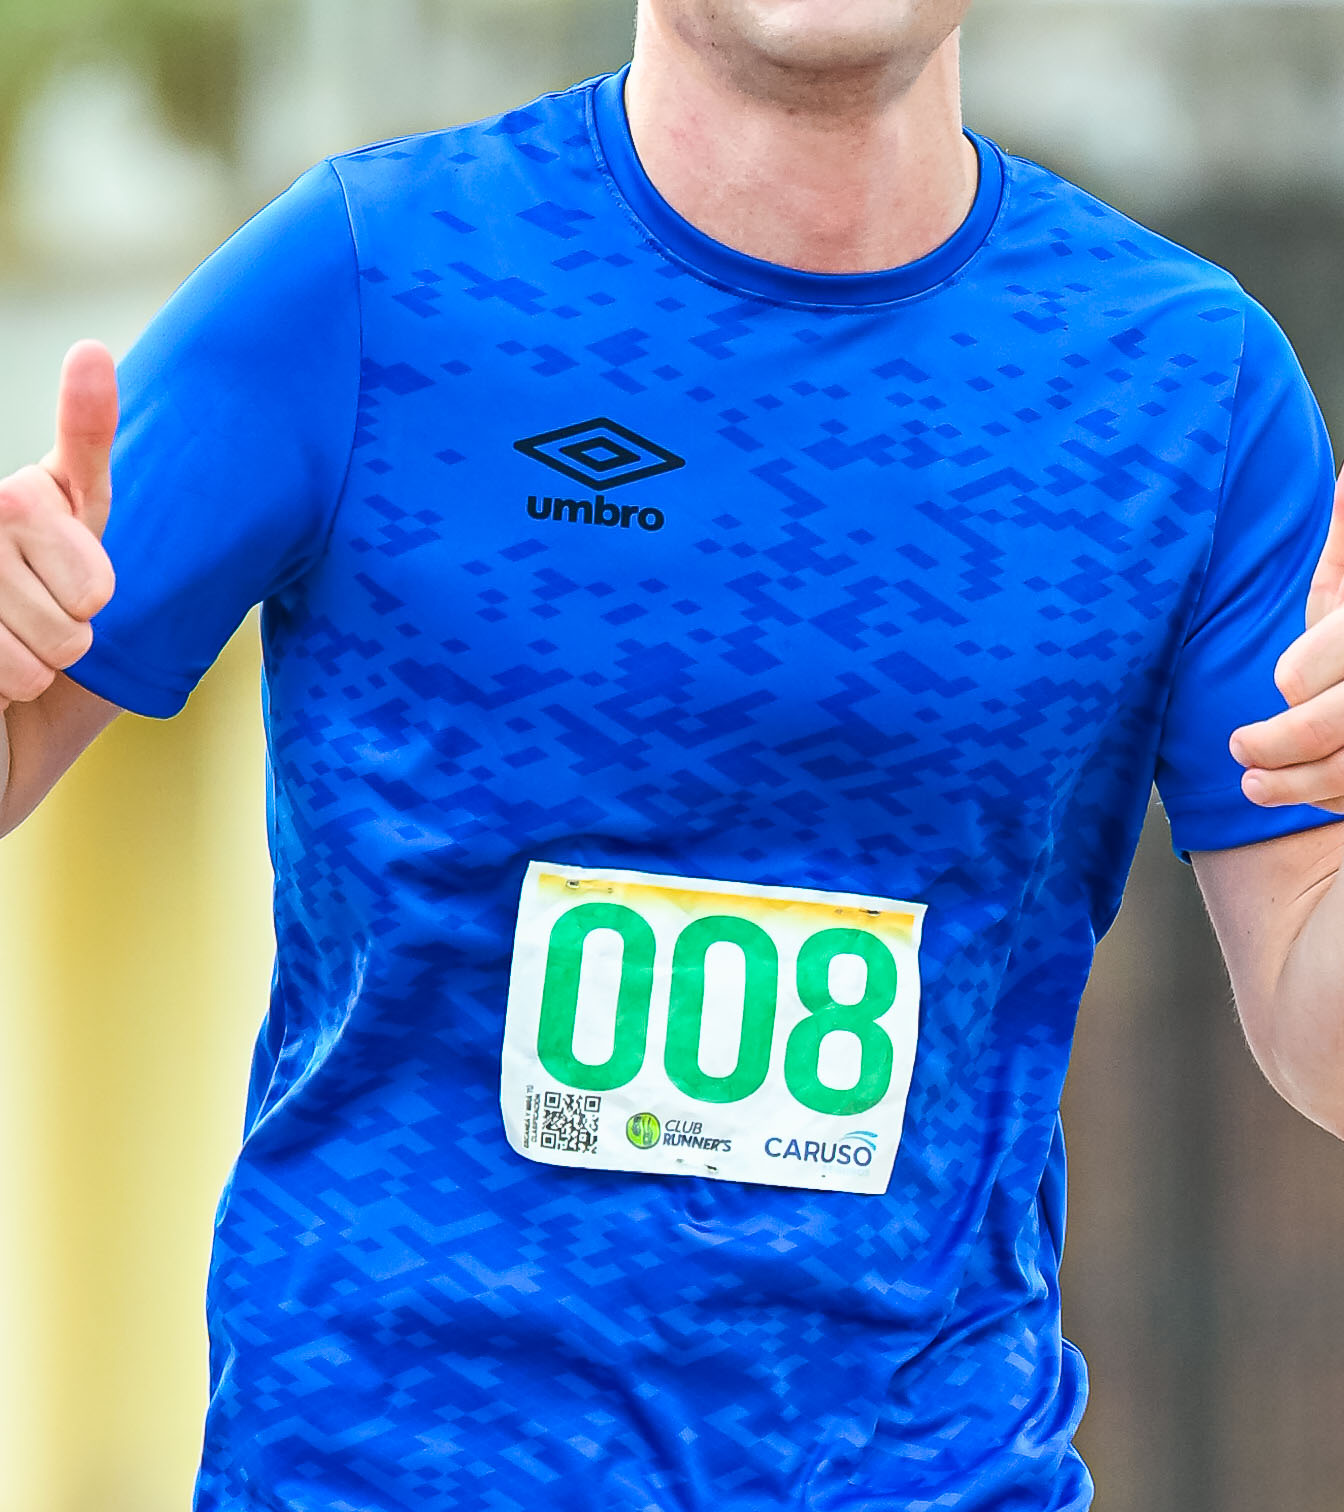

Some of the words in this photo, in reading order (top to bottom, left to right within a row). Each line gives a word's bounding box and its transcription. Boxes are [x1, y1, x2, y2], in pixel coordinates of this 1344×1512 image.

[527, 494, 665, 532] umbro
[537, 902, 897, 1116] 008
[664, 1119, 703, 1135] CLUB
[764, 1137, 872, 1167] CARUSO
